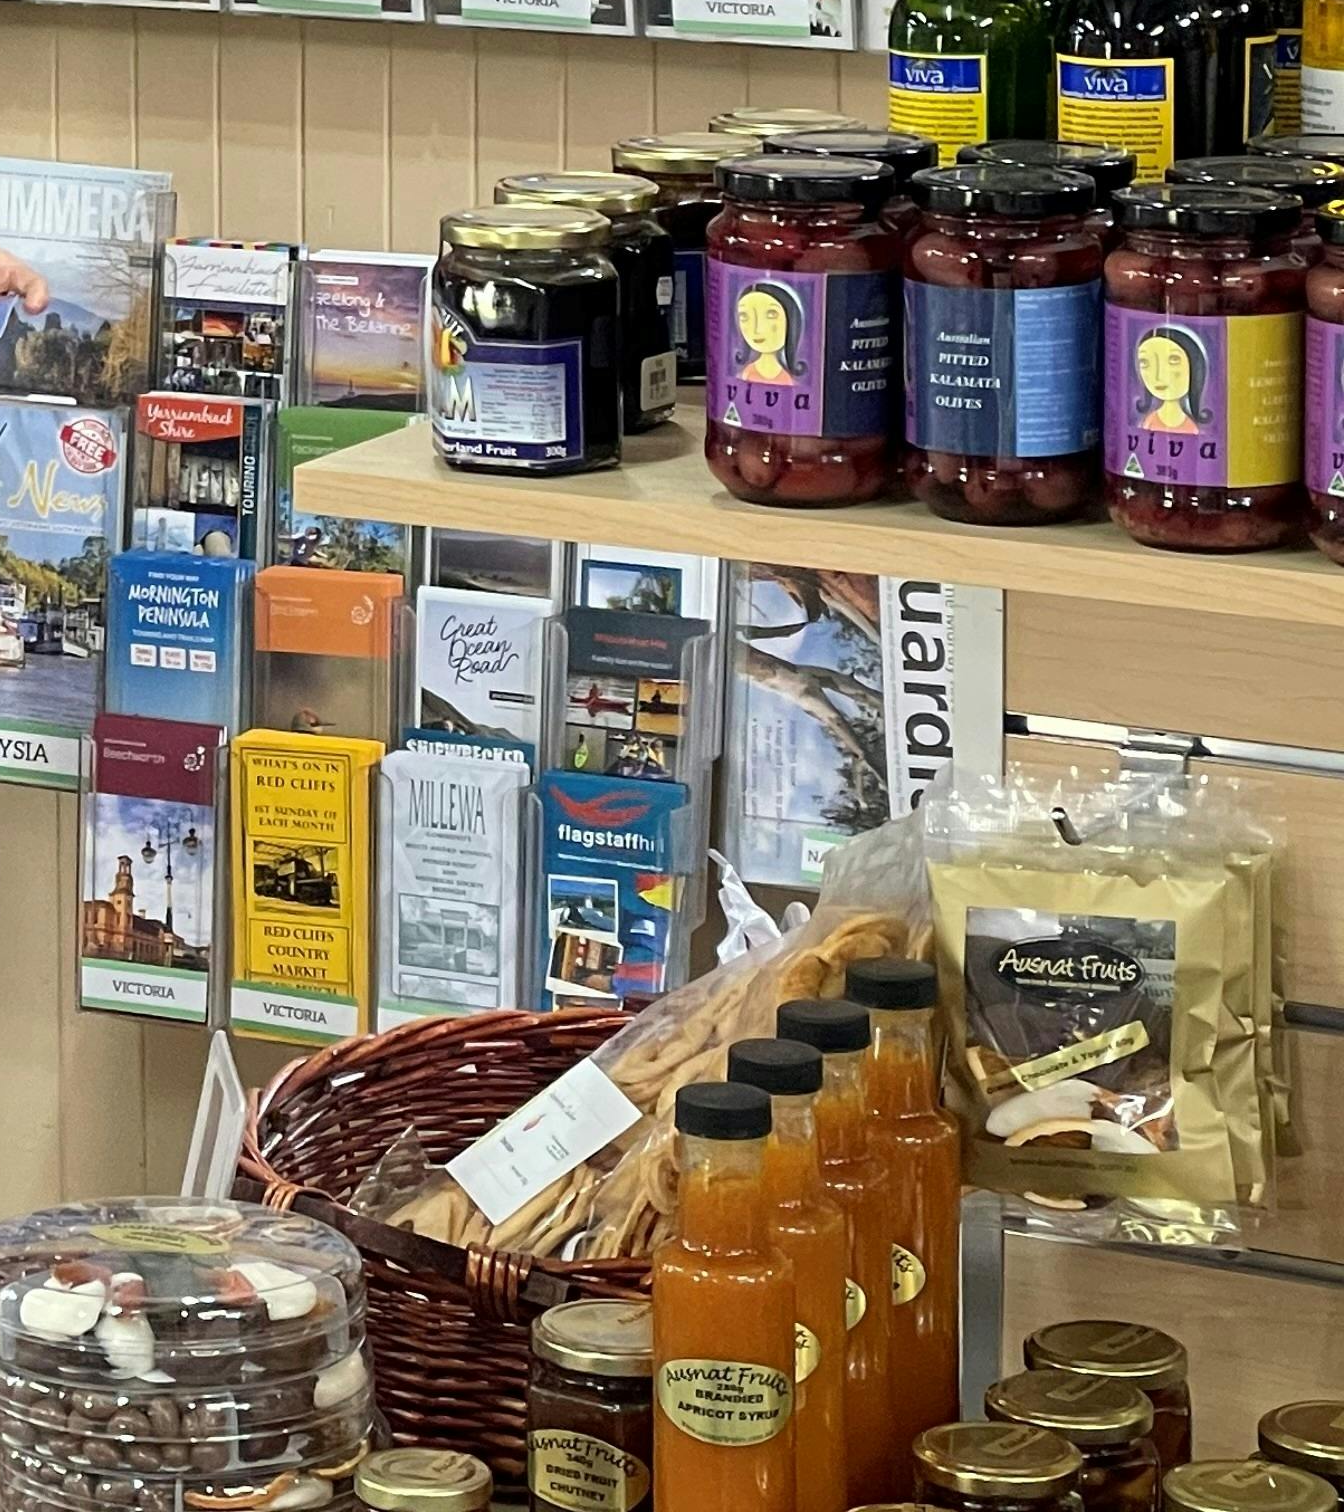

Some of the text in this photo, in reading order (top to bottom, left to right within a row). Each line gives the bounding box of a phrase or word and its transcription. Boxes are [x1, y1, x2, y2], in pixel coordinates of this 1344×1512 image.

[706, 0, 776, 18] VICTORIA
[938, 352, 990, 366] PITTED
[929, 372, 1002, 390] KALAMATA
[935, 396, 982, 410] OLIVES
[159, 419, 195, 440] Shire
[69, 432, 106, 459] FREE
[485, 443, 517, 456] Fruit
[241, 453, 256, 517] TOURING
[128, 584, 219, 608] MORNINGTON
[137, 603, 210, 628] PENINSULA
[440, 615, 498, 640] Great
[448, 637, 512, 668] Ocean
[103, 746, 166, 764] Beechworth
[252, 756, 322, 773] WHAT'S ON
[255, 775, 336, 793] RED CLIFFS
[274, 806, 319, 819] SUNDAY
[408, 778, 486, 836] MILLEWA
[289, 817, 335, 832] MONTH
[263, 925, 334, 942] RED CLIFFS
[266, 944, 330, 961] COUNTRY
[272, 963, 327, 979] MARKET
[998, 948, 1137, 982] Ausnat Fruits
[112, 980, 175, 999] VICTORIA
[263, 1002, 328, 1024] VICTORIA
[1021, 1058, 1069, 1083] Chocolate
[666, 1366, 732, 1387] Ausnat
[695, 1388, 764, 1404] BRANDIED
[677, 1401, 780, 1421] APRICOT SYRUP
[545, 1464, 619, 1489] DRIED FRUIT
[549, 1480, 607, 1502] CHUTNEY
